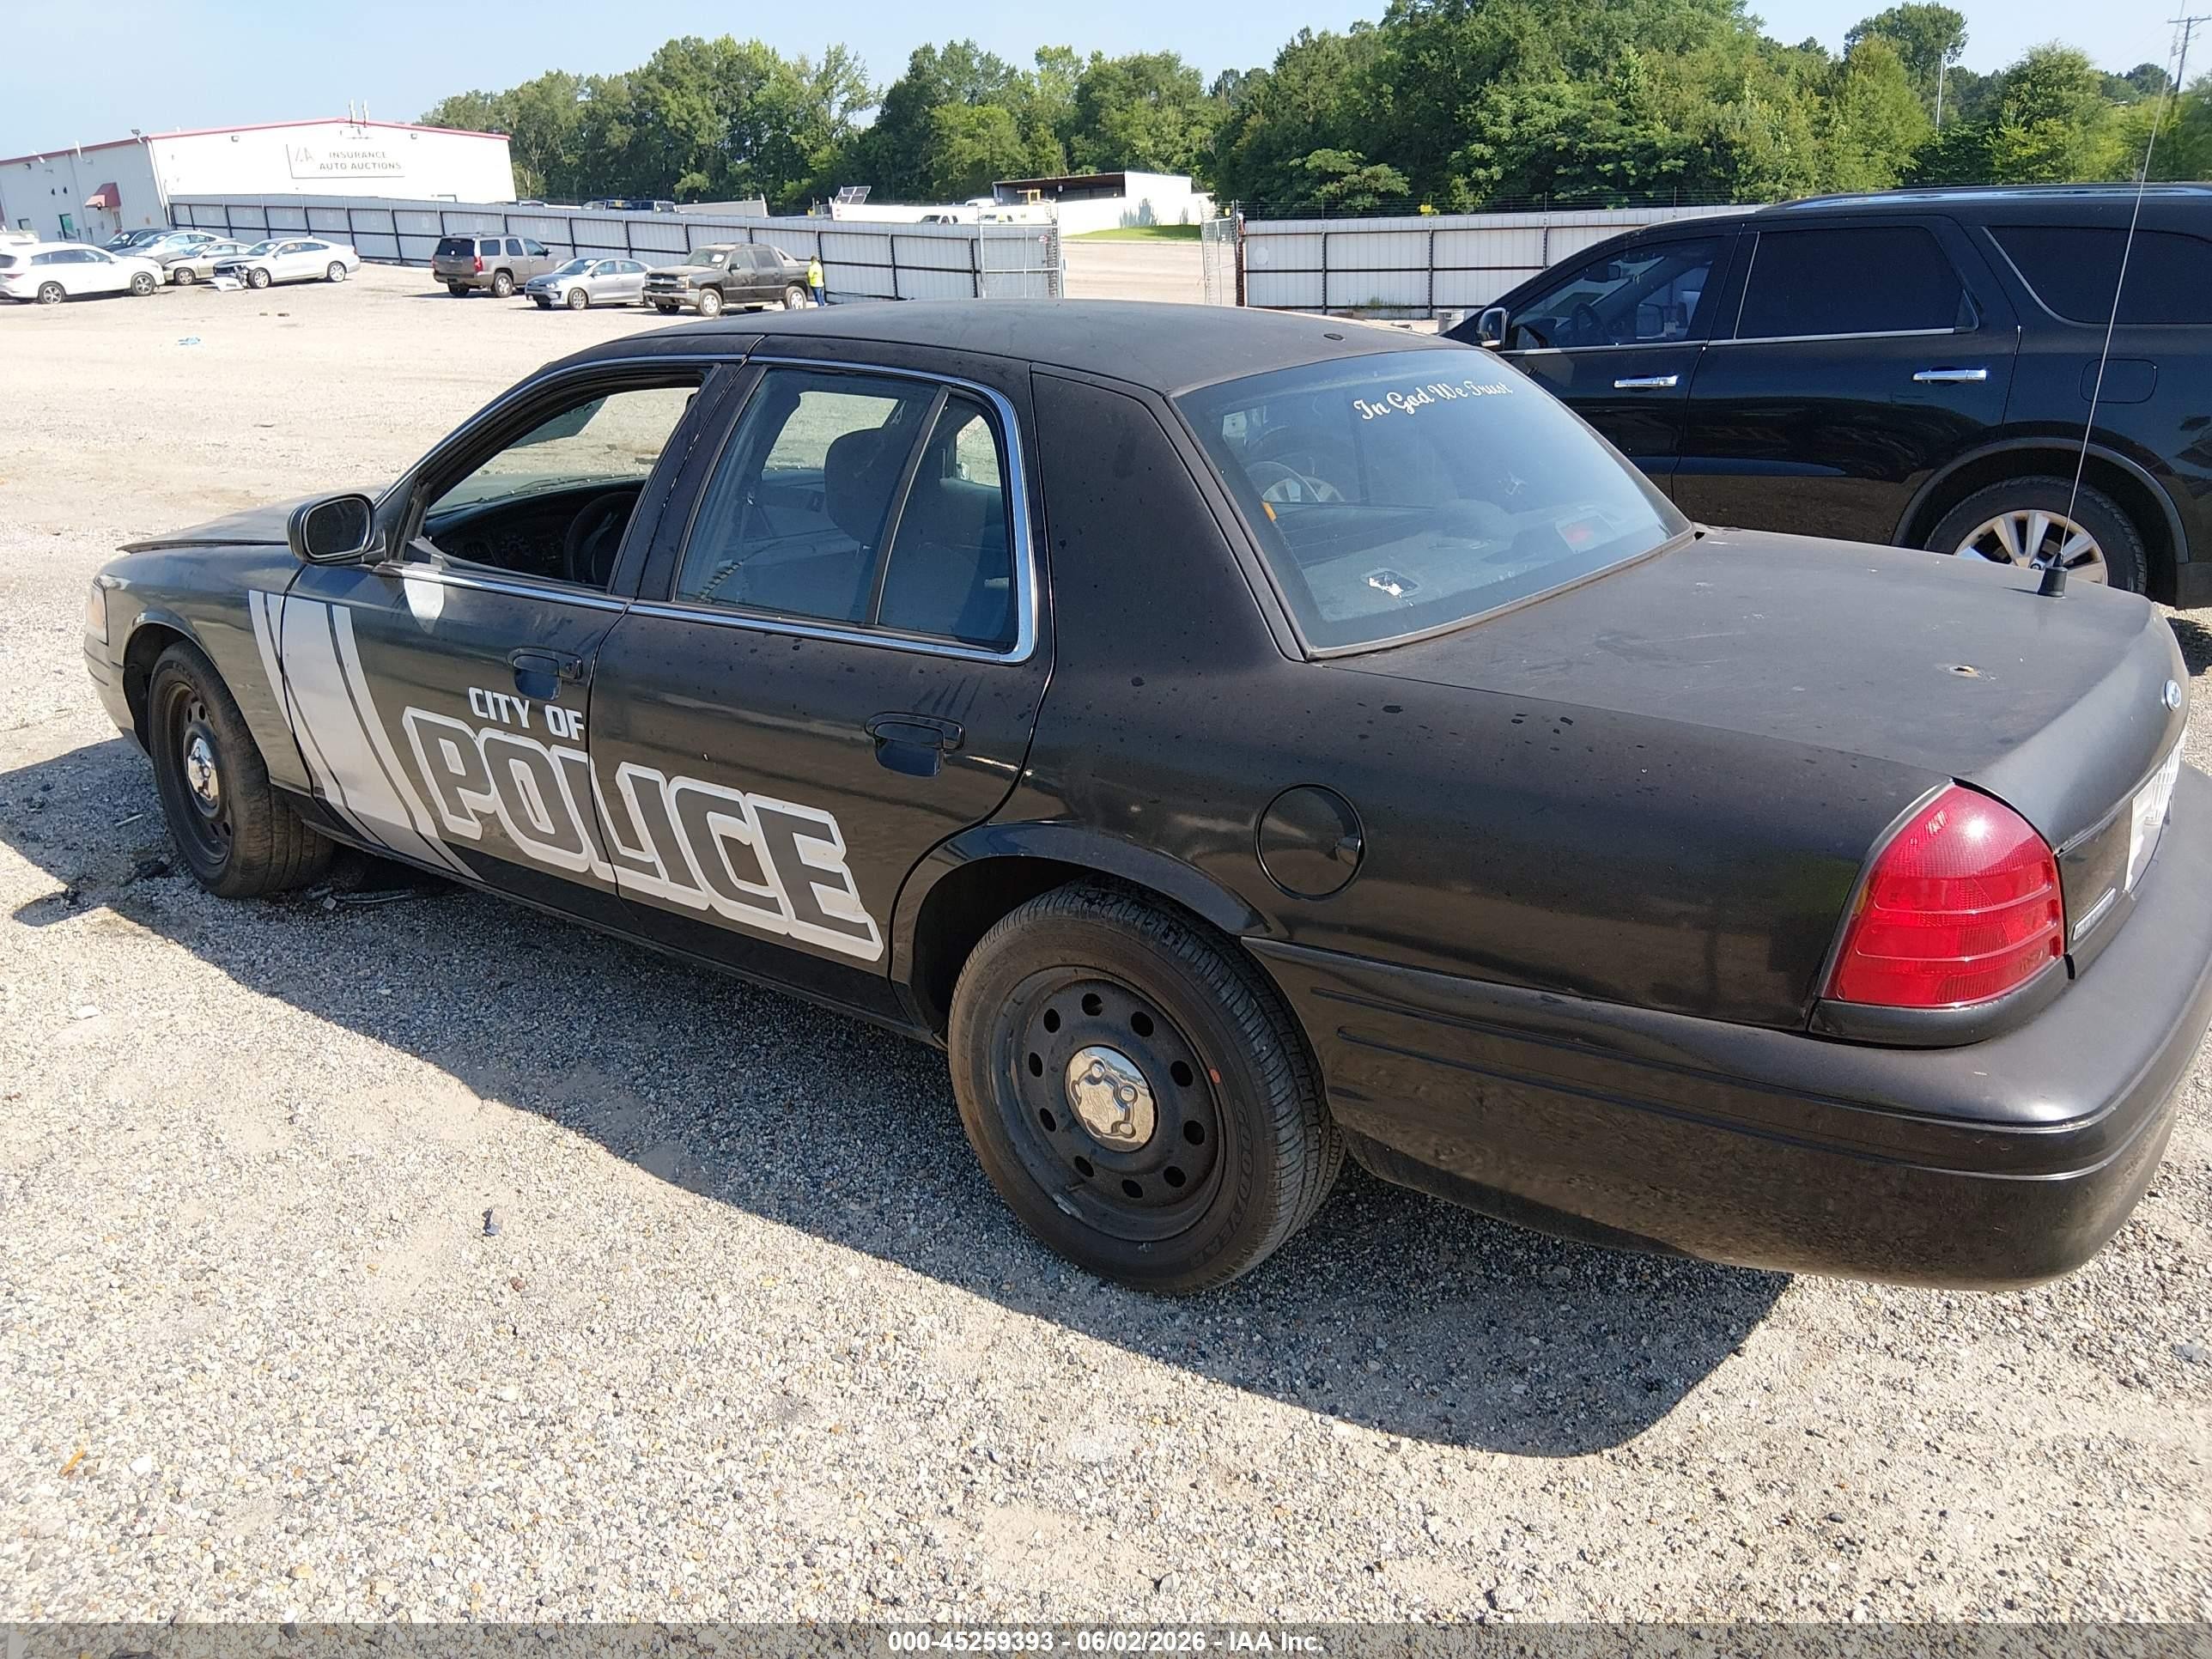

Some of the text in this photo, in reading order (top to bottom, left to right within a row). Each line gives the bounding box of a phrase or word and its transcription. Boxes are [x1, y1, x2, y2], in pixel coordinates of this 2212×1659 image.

[1353, 380, 1513, 420] In God We Trust
[468, 687, 585, 741] CITY OF
[403, 706, 884, 961] POLICE
